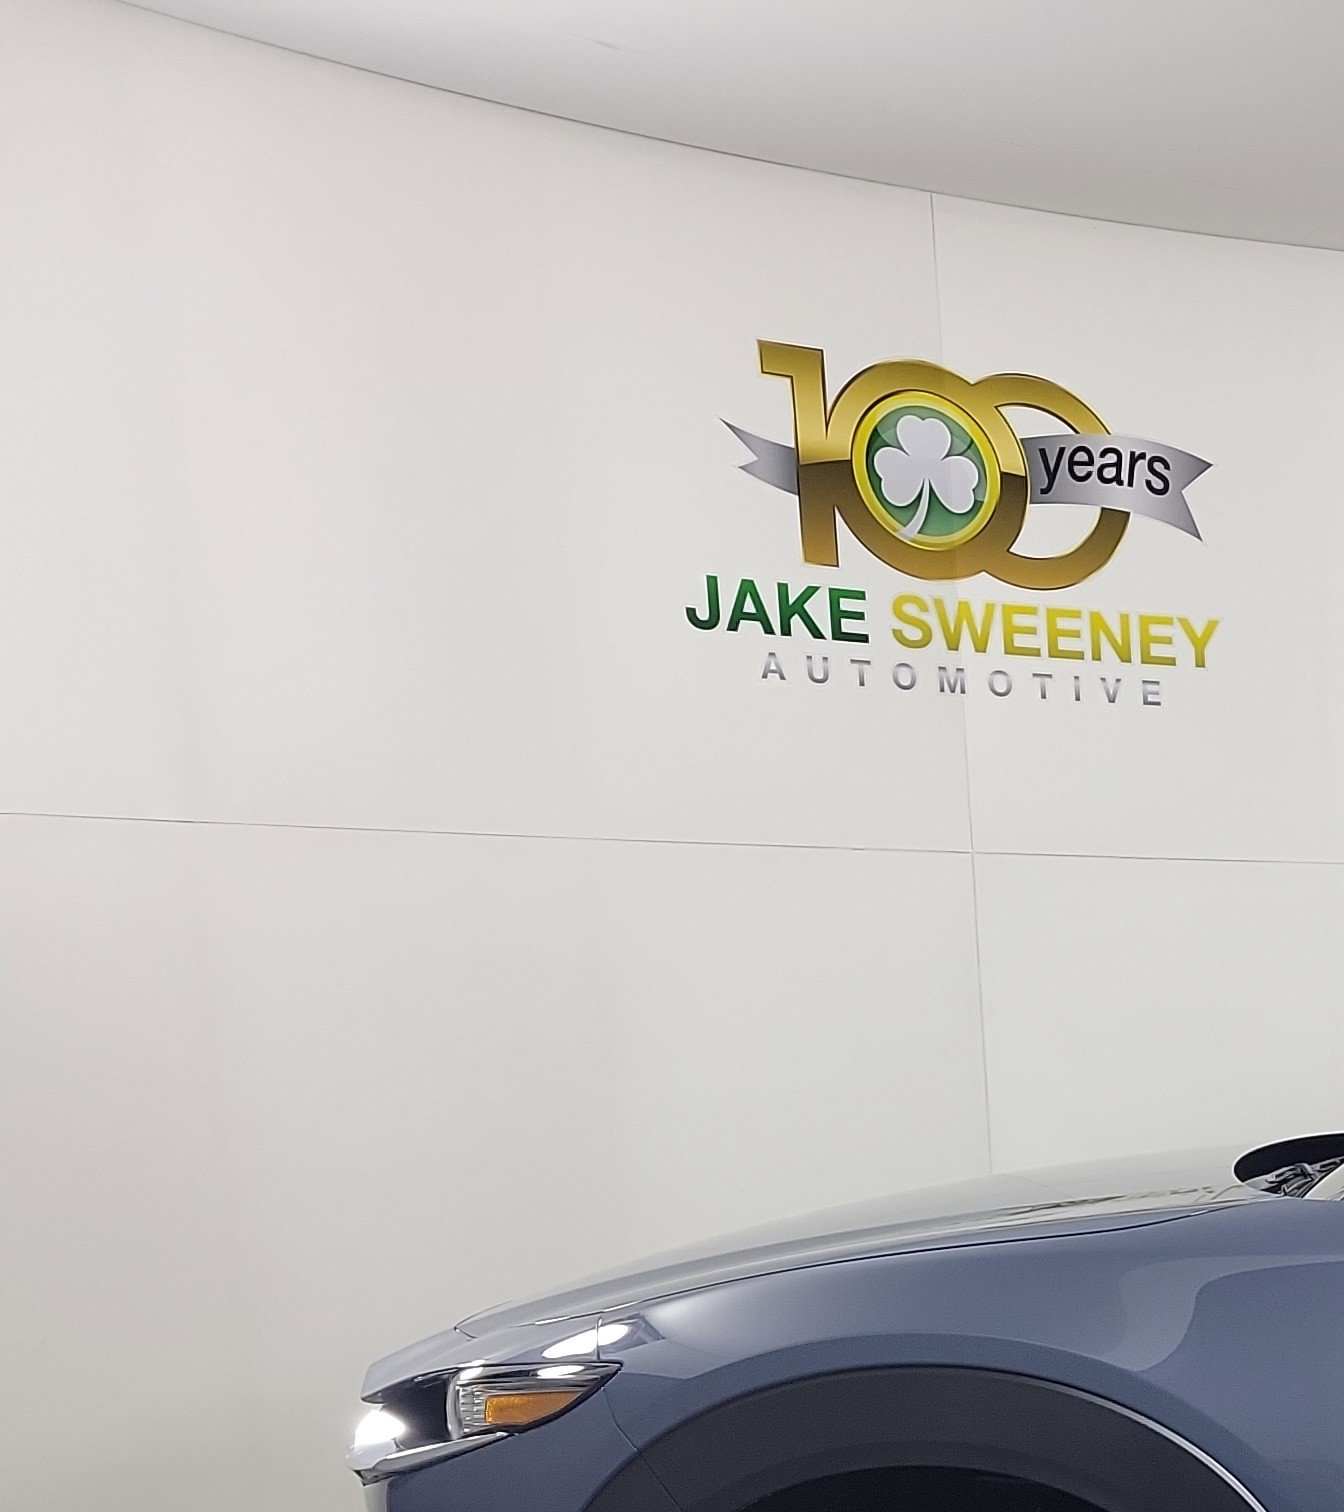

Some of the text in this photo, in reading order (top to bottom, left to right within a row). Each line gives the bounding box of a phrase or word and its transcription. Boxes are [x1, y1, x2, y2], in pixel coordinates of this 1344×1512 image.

[756, 339, 1171, 591] 100 years
[685, 575, 1220, 668] JAKE SWEENEY
[761, 651, 1162, 706] AUTOMOTIVE
